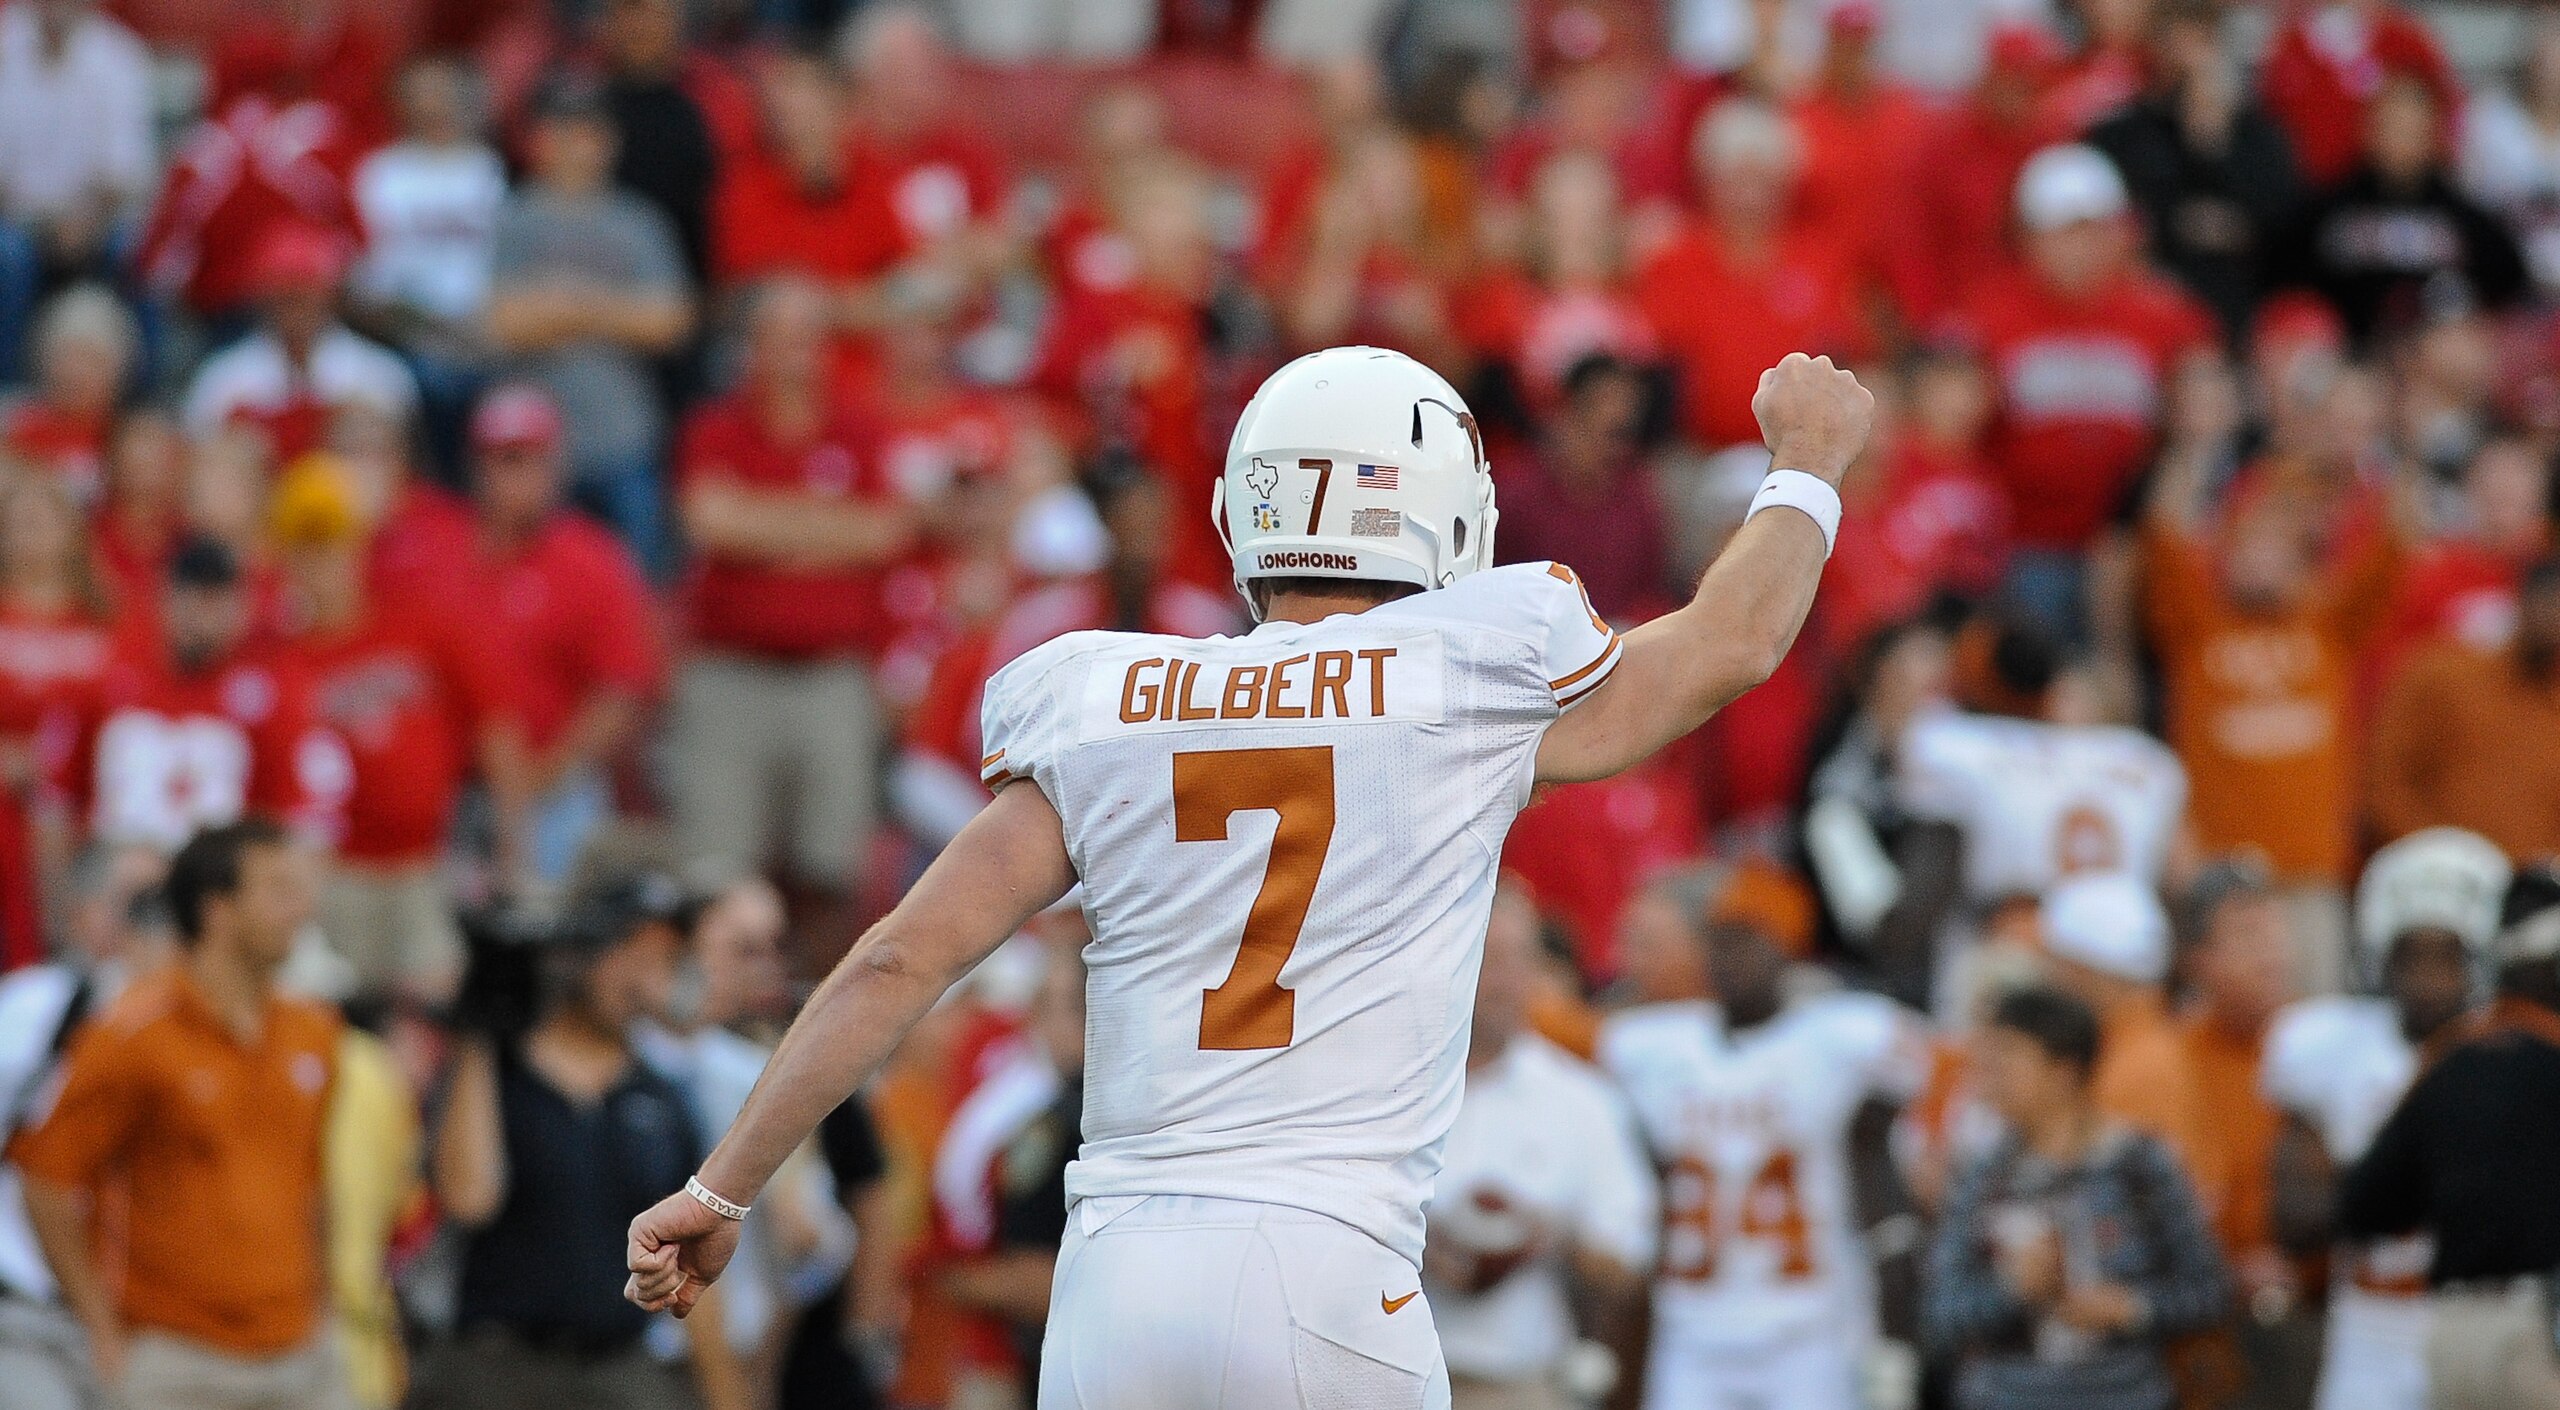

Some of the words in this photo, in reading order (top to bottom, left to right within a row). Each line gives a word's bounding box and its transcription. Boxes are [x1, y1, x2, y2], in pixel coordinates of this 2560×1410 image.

[1298, 458, 1333, 536] 7
[1257, 552, 1358, 571] LONGHORNS
[1119, 648, 1397, 724] GILBERT
[1173, 745, 1337, 1051] 7
[706, 1195, 743, 1218] TEXAS
